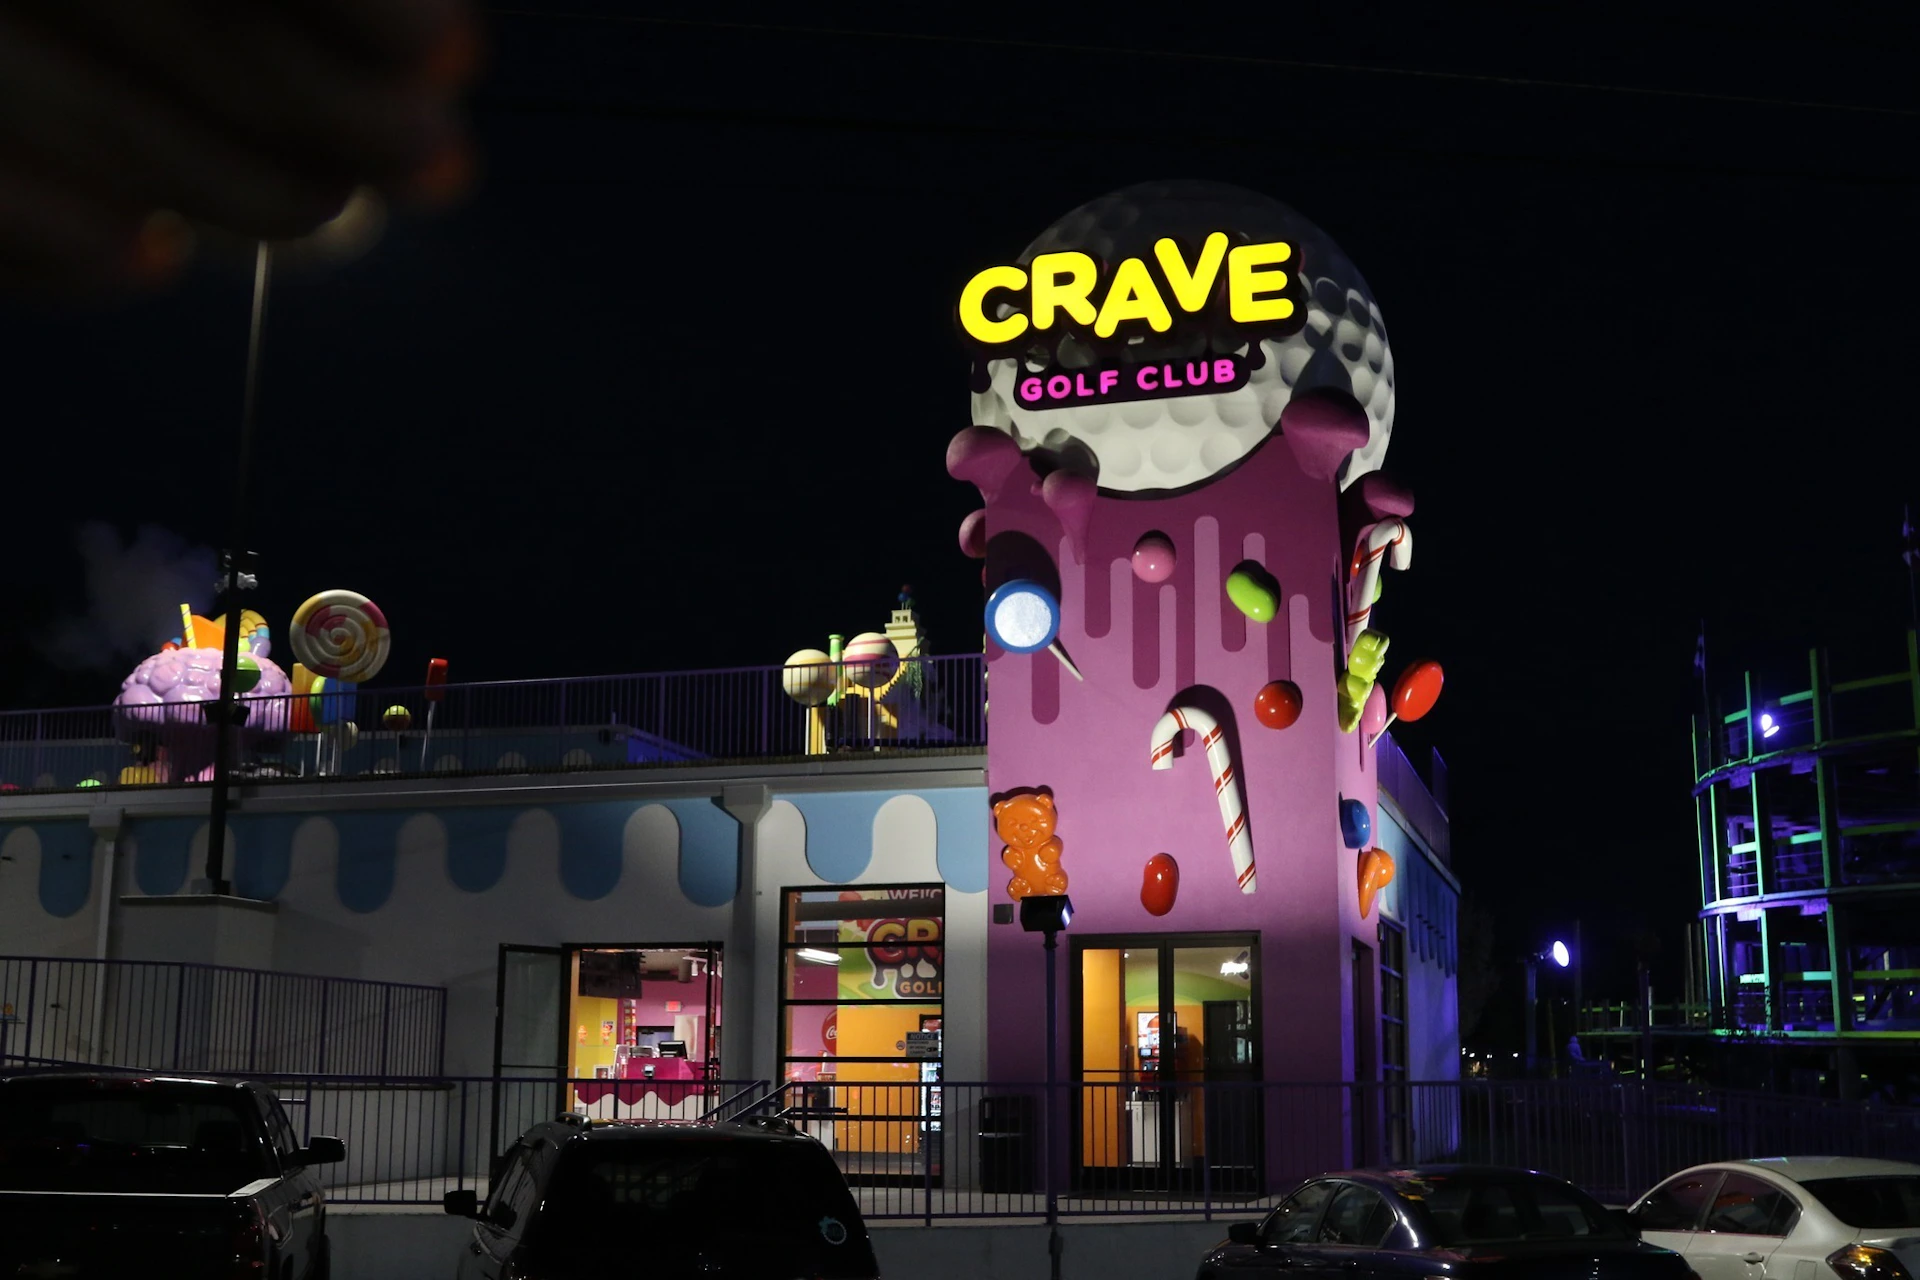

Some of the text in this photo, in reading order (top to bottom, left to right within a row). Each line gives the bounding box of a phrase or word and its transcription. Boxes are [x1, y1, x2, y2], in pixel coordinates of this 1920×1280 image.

[959, 231, 1294, 344] CRAVE
[1020, 359, 1236, 401] GOLF CLUB
[872, 918, 942, 964] CR
